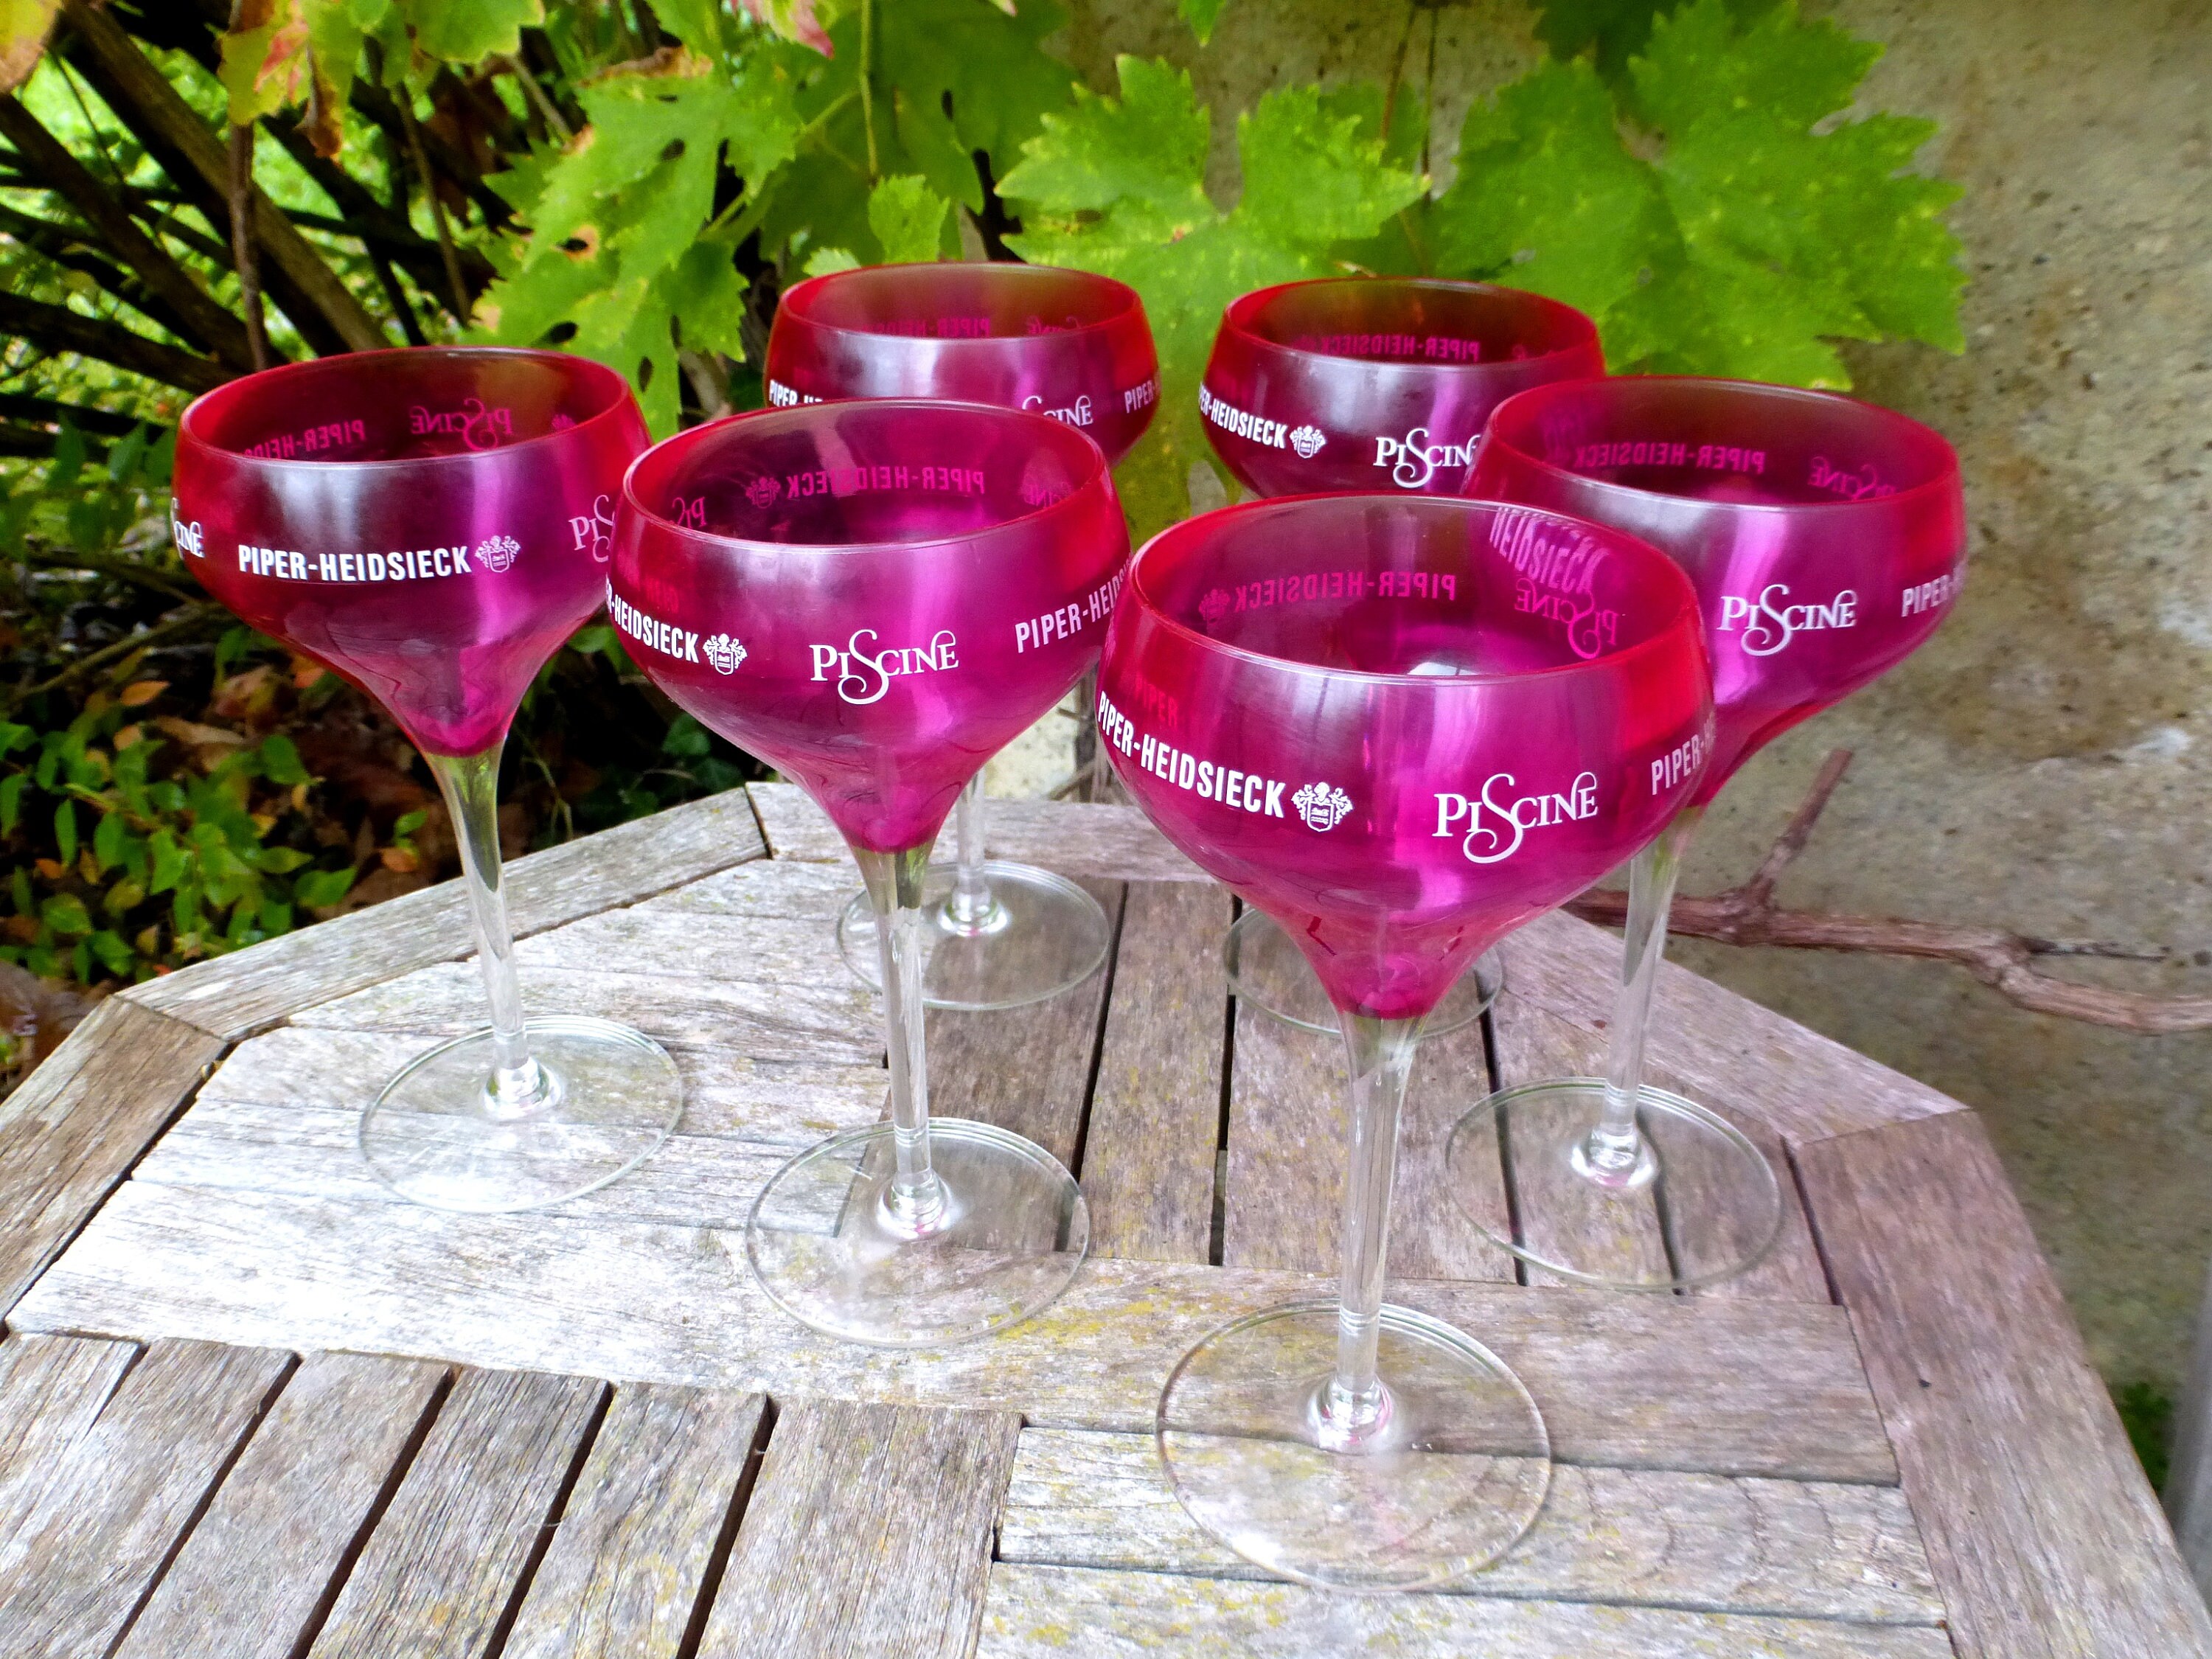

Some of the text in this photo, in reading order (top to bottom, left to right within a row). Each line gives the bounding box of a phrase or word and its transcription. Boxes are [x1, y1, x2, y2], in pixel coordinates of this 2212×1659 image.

[1372, 427, 1481, 489] PISCIN
[237, 543, 472, 582] PIPER-HEIDSIECK
[1716, 583, 1858, 656] PISCINE
[808, 628, 959, 706] PISCINE
[1097, 689, 1287, 819] PIPER-HEIDSIECK
[1431, 771, 1599, 864] PISCINE
